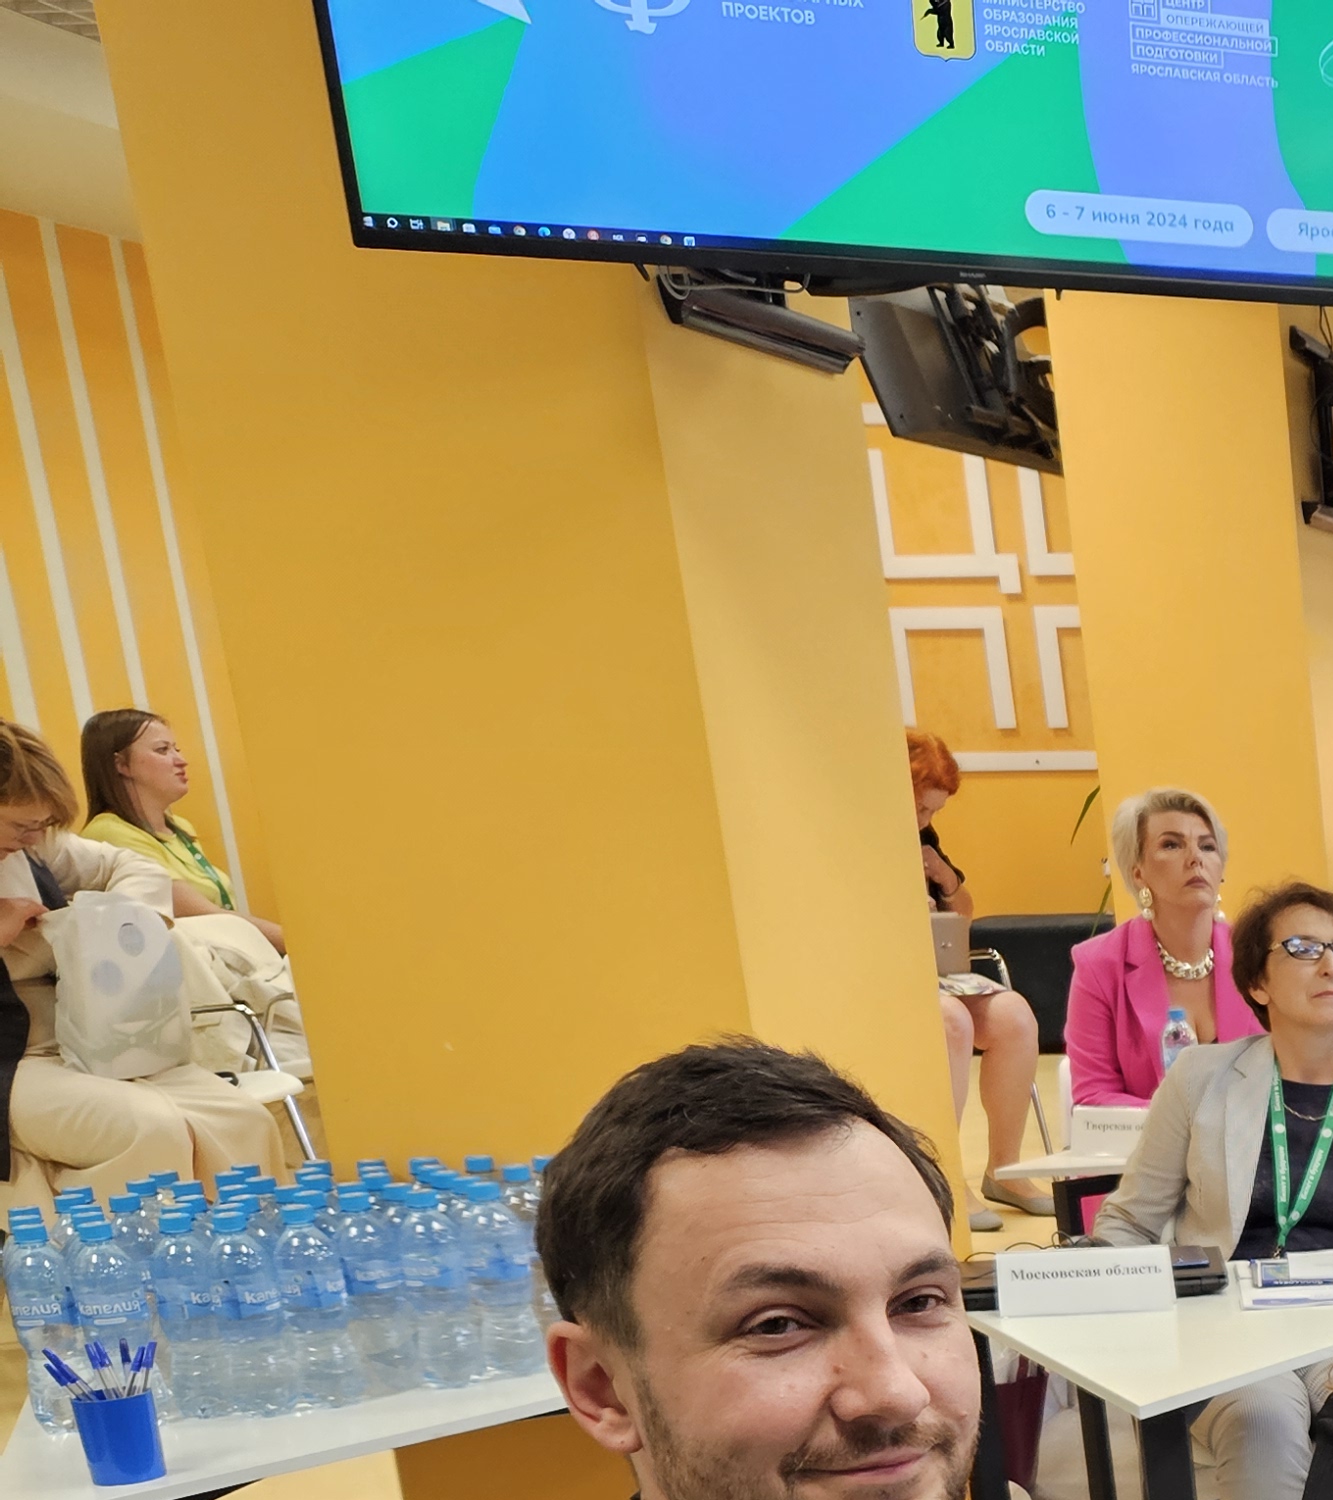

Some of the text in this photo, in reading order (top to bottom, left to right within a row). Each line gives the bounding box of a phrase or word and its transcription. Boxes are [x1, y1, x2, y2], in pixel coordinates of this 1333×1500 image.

[722, 2, 815, 25] ПРОЕКТОВ
[983, 8, 1078, 29] ОБРАЗОВАНИЯ
[1166, 14, 1265, 34] ОПЕРЕЖАЮЩЕЙ
[984, 24, 1080, 45] ЯРОСЛАВСКОЙ
[1135, 28, 1272, 52] ПРОФЕССИОНАЛЬНОЙ
[985, 40, 1046, 57] ОБЛАСТИ
[1136, 45, 1218, 64] ПОДГОТОВКИ
[1131, 63, 1279, 89] ЯРОСЛАВСКАЯ ОБЛАСТЬ
[1046, 203, 1056, 220] 6
[1075, 206, 1086, 221] 7
[1092, 210, 1141, 227] июня
[1146, 211, 1189, 229] 2024
[1194, 217, 1235, 236] года
[1085, 1121, 1132, 1134] Тверская
[1010, 1264, 1162, 1282] Московская область
[11, 1302, 62, 1316] апелия
